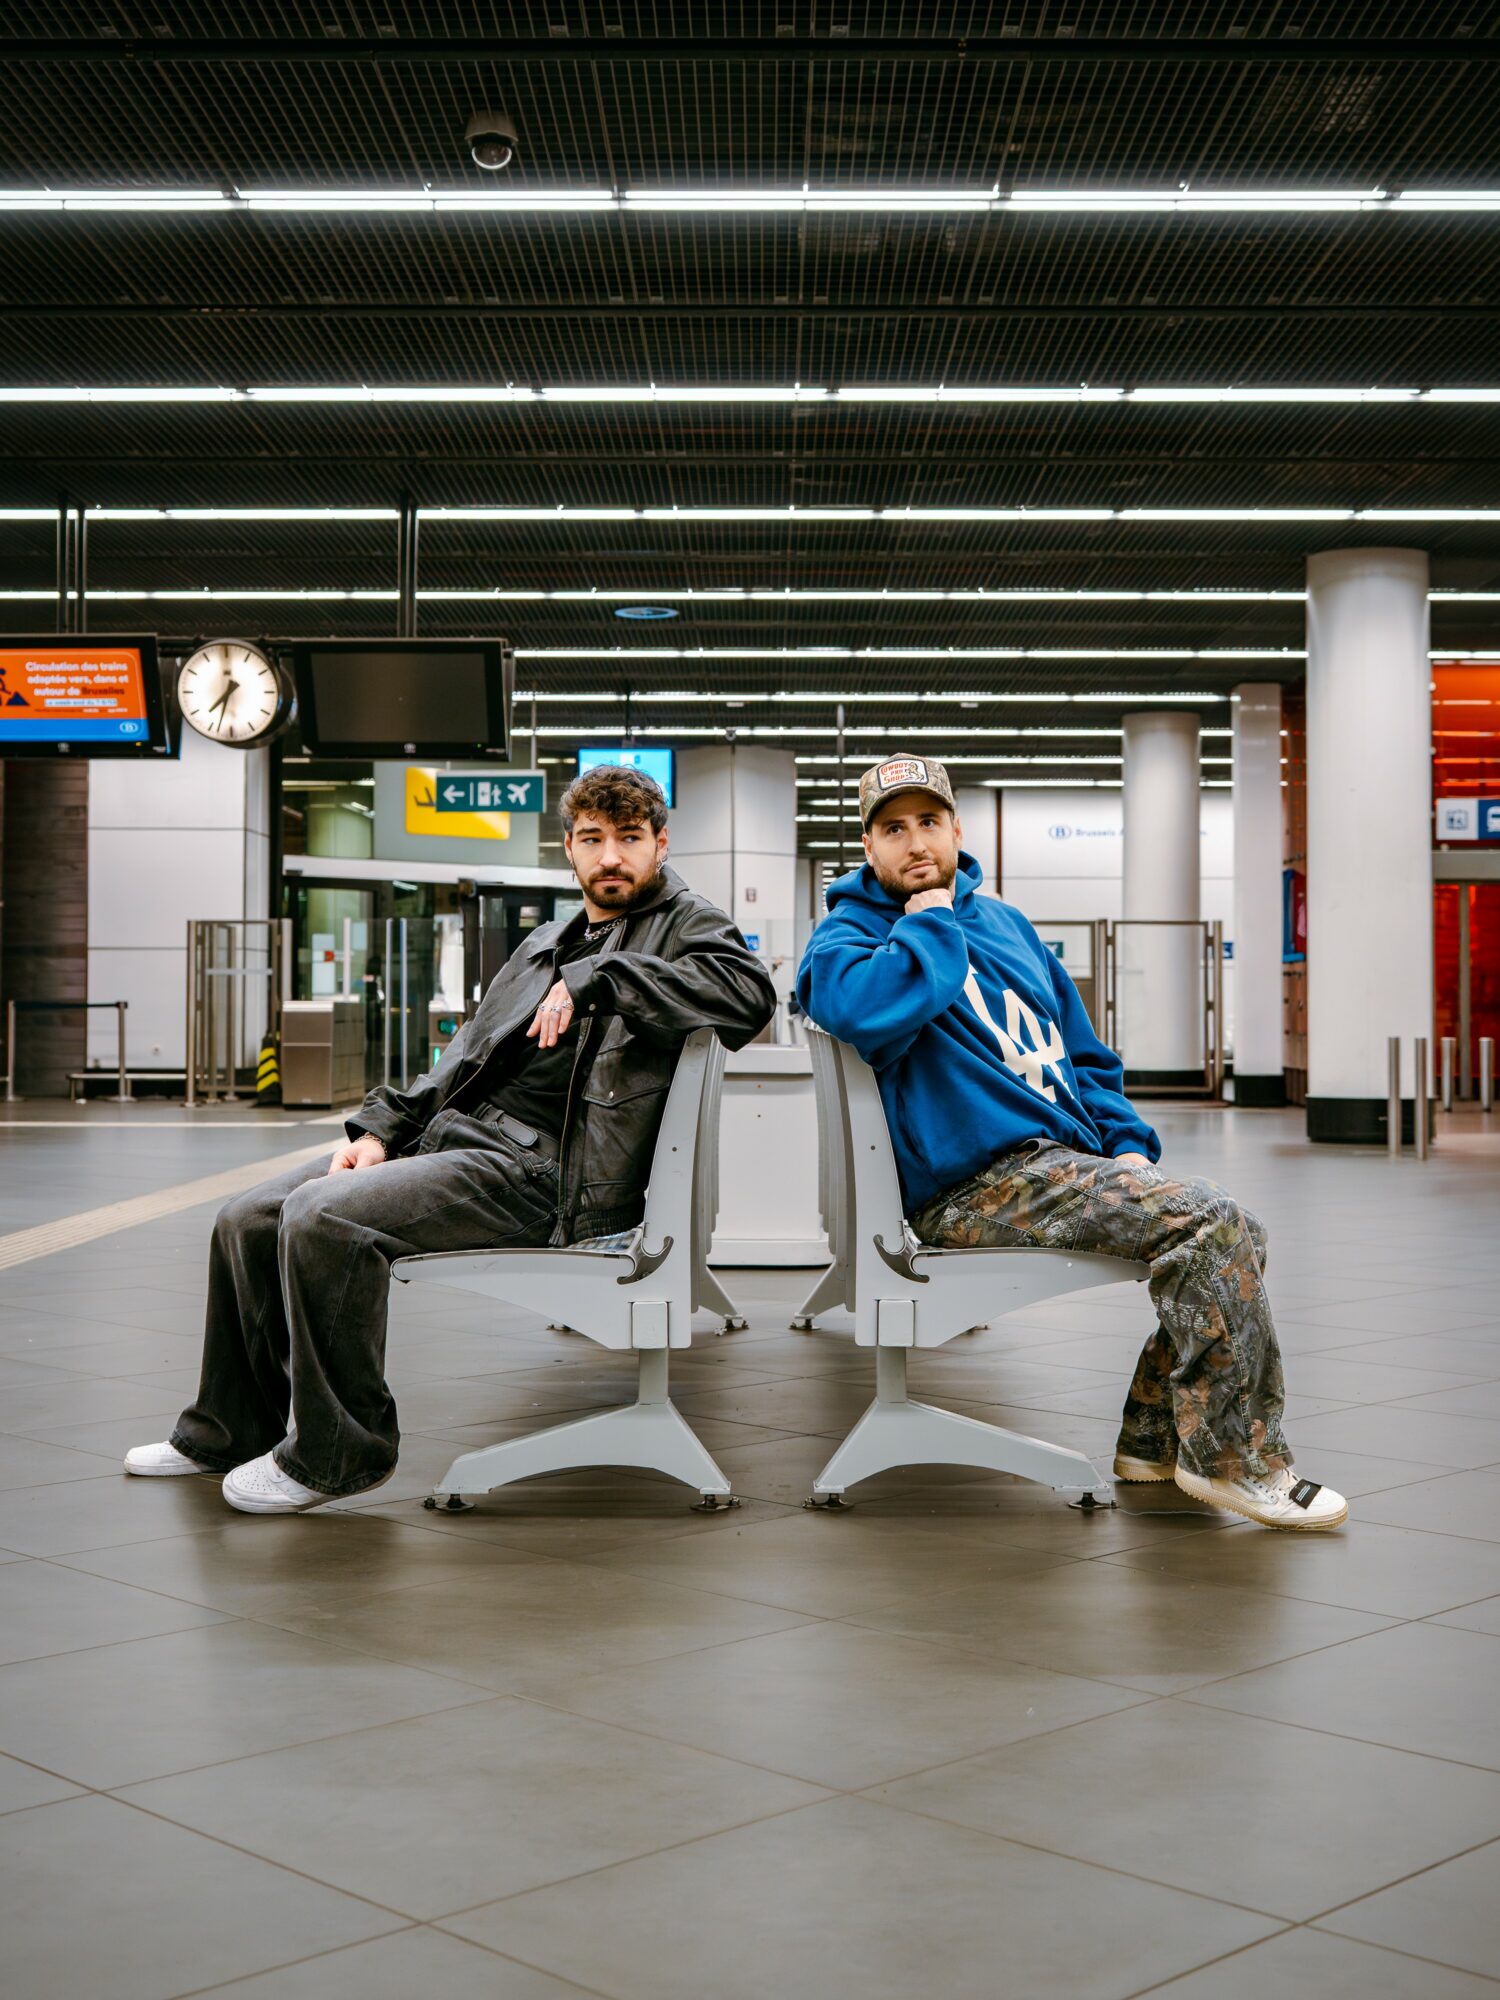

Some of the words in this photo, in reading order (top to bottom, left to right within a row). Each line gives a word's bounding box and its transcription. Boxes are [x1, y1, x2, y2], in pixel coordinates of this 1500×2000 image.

[25, 661, 79, 671] Circulation
[81, 661, 98, 671] des
[100, 661, 128, 671] trains
[69, 675, 92, 685] vers,
[93, 673, 117, 684] dans
[118, 674, 128, 684] et
[33, 687, 65, 697] autour
[67, 686, 80, 697] de
[81, 686, 125, 696] Bruxelles
